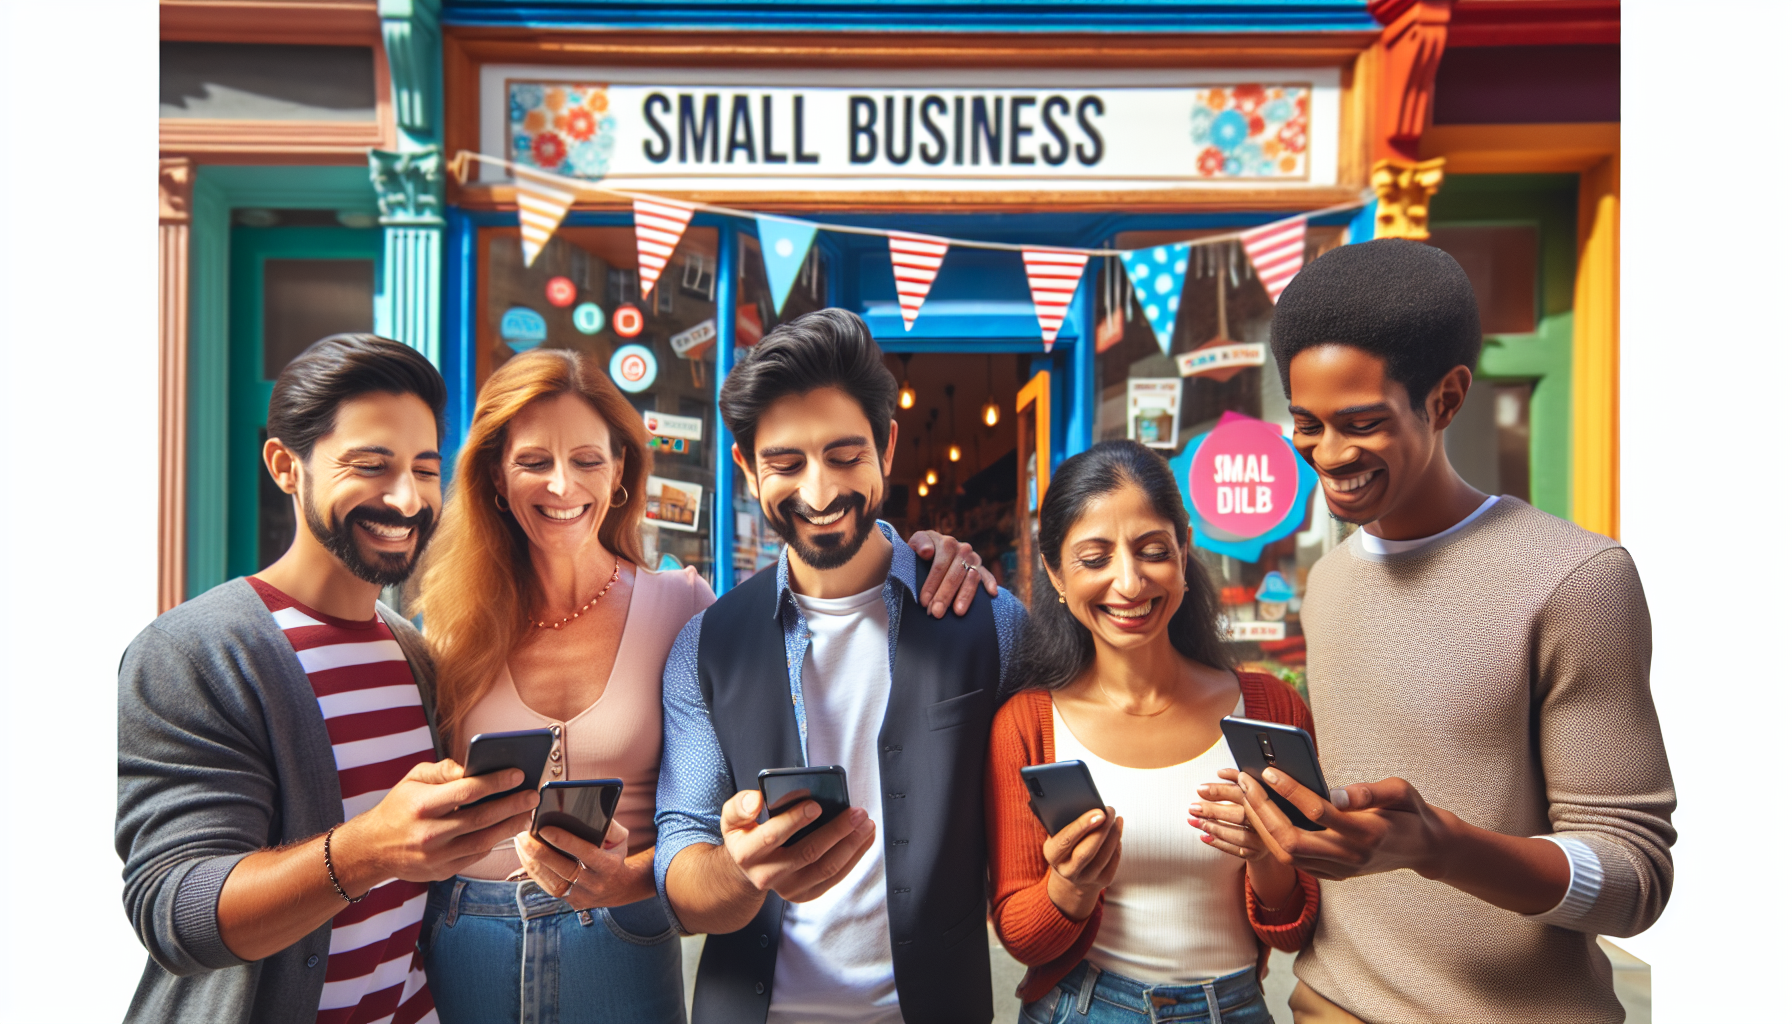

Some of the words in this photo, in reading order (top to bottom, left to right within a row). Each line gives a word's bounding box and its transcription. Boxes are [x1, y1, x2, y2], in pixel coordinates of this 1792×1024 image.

[643, 92, 820, 164] SMALL
[848, 94, 1105, 166] BUSINESS
[1214, 454, 1275, 483] SMAL
[1217, 486, 1273, 514] DILB
